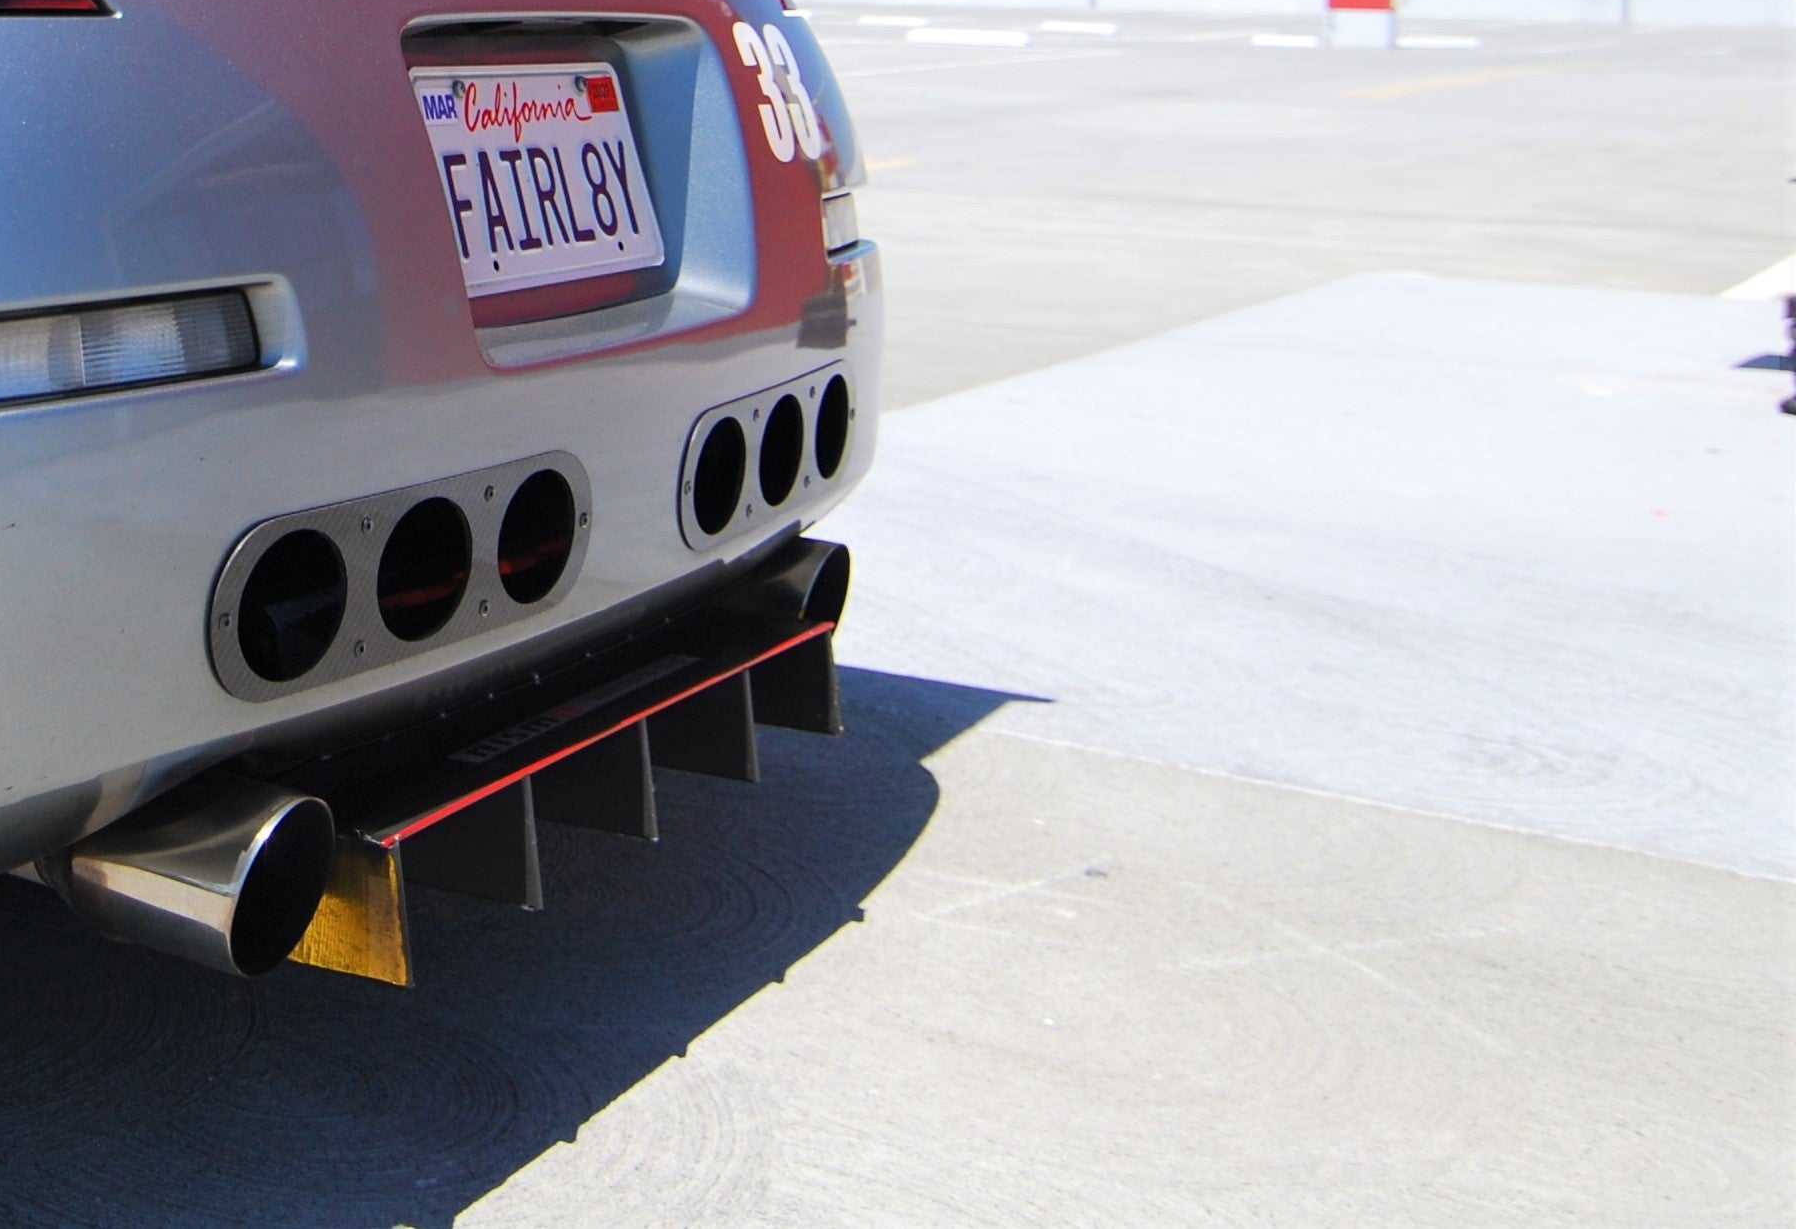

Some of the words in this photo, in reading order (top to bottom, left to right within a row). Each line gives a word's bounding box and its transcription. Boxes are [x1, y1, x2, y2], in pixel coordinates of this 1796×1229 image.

[422, 94, 458, 120] MAR
[463, 81, 593, 144] California
[732, 21, 821, 164] 33
[442, 140, 640, 260] FAIRL8Y
